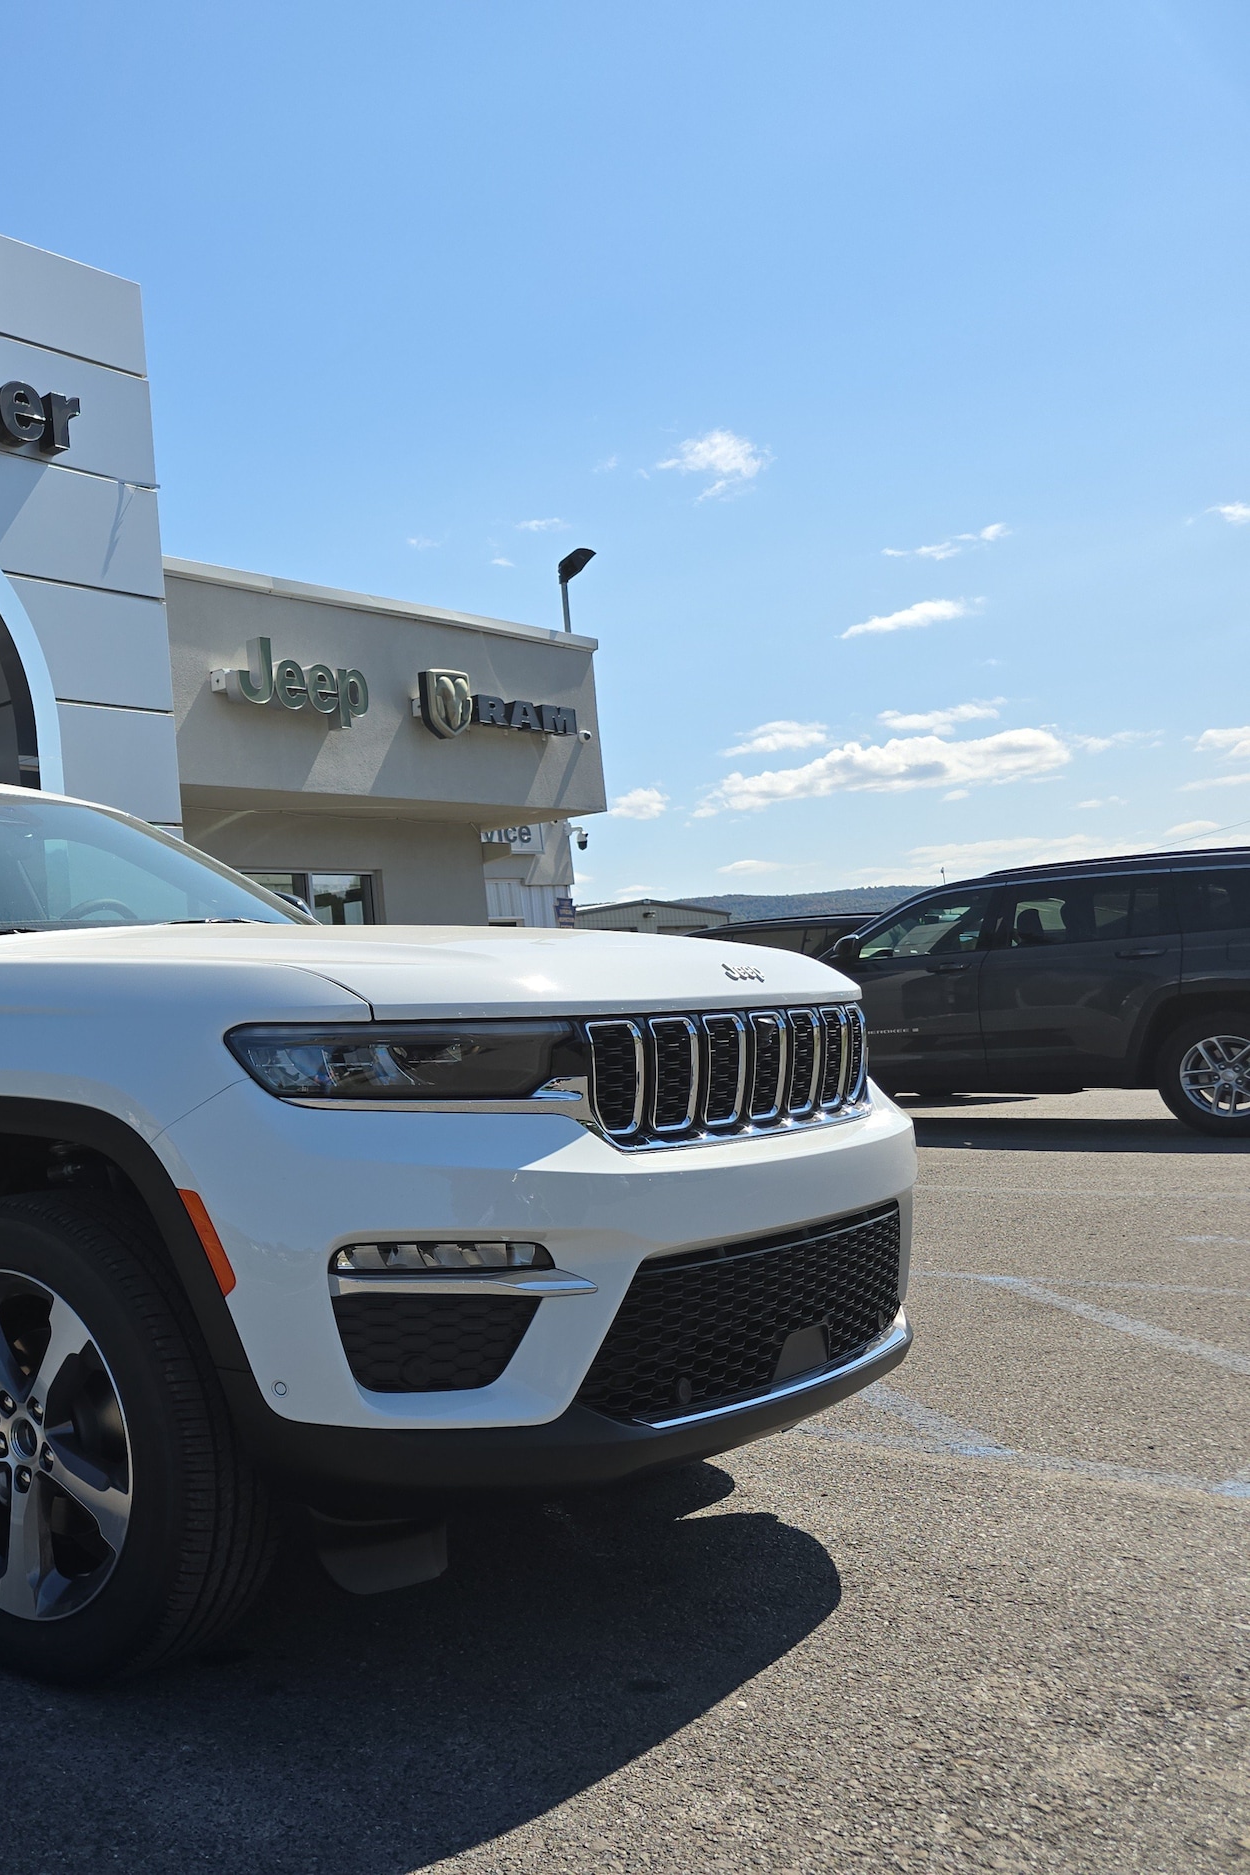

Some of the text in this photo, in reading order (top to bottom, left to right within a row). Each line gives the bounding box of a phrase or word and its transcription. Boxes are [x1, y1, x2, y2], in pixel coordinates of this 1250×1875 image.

[227, 636, 369, 730] Jeep
[470, 694, 577, 736] RAM
[721, 963, 765, 983] Jeep
